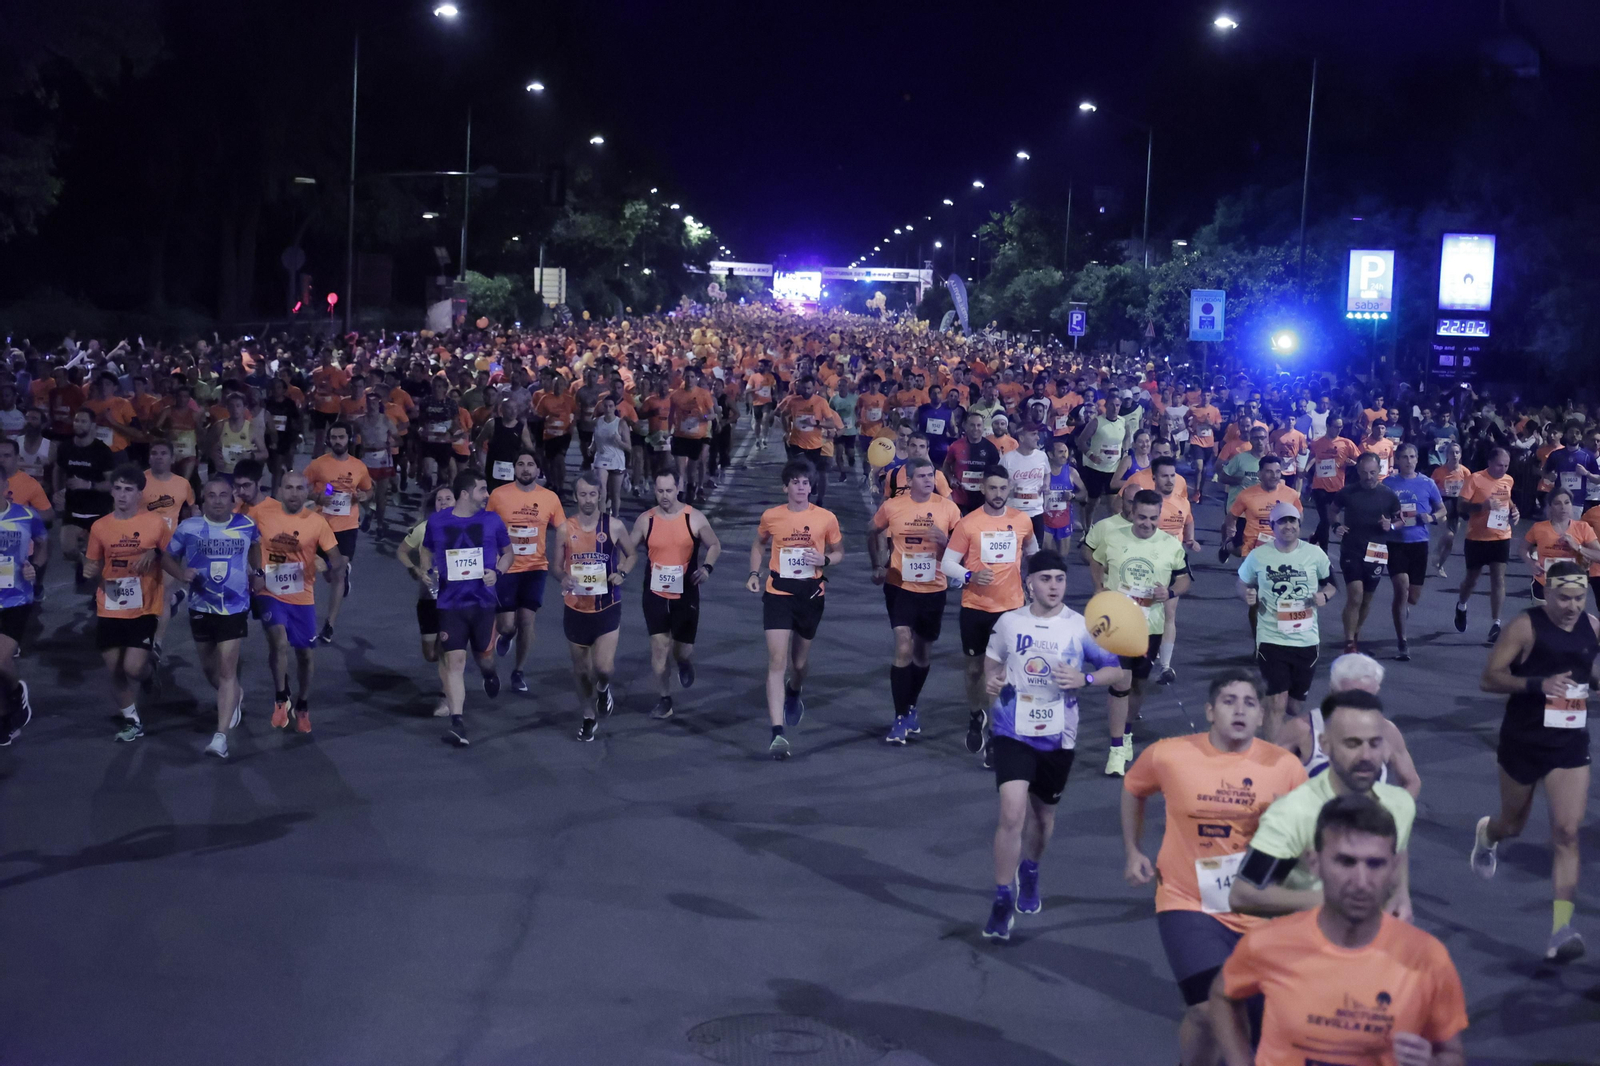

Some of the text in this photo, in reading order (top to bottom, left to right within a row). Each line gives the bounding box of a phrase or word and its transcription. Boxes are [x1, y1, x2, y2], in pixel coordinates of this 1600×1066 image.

[1360, 255, 1385, 290] P
[1355, 301, 1379, 310] saba
[1072, 313, 1082, 325] P
[1440, 320, 1486, 334] 22:02
[989, 541, 1012, 550] 20567
[455, 558, 477, 567] 17754
[787, 558, 809, 566] 1343
[909, 562, 931, 570] 13433
[275, 573, 298, 582] 16510
[583, 574, 597, 583] 295
[659, 574, 676, 582] 5578
[1289, 611, 1306, 620] 1359
[1032, 640, 1059, 650] HUELVA
[1029, 708, 1054, 719] 4530
[1216, 789, 1256, 798] NOCTURNA
[1197, 794, 1255, 806] SEVILLA KM7
[1307, 1014, 1360, 1030] SEVILLA
